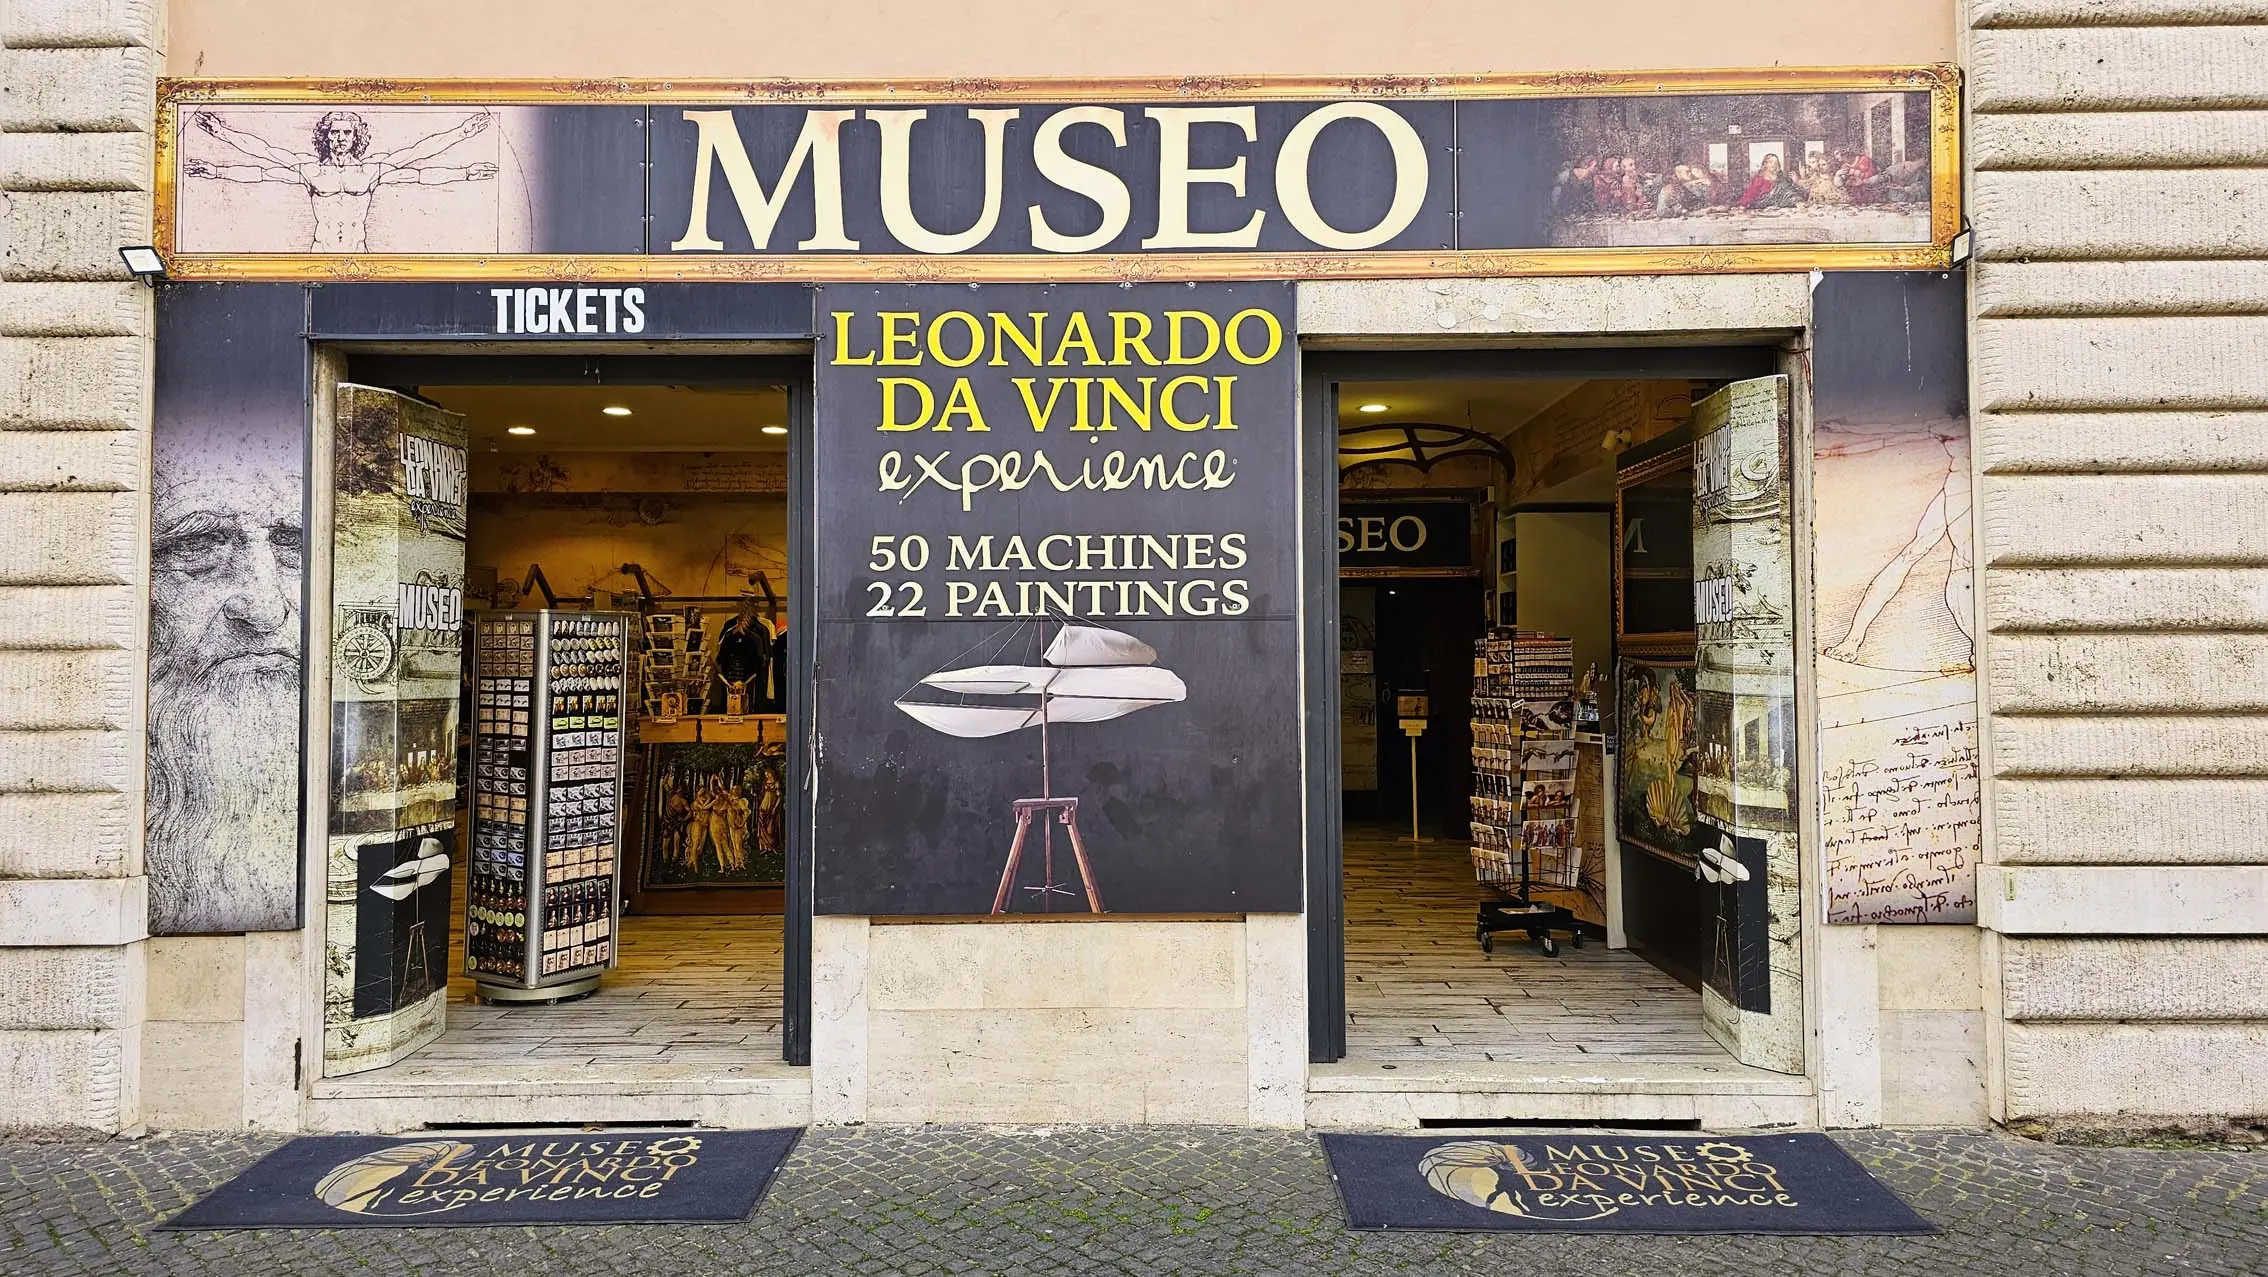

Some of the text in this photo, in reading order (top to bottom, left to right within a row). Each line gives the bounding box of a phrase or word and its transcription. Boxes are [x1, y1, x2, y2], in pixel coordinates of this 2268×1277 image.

[671, 101, 1429, 253] MUSEO
[490, 287, 645, 334] TICKETS
[830, 308, 1282, 367] LEONARDO
[877, 374, 1239, 432] DA VINCI
[399, 432, 467, 473] LEONARDO
[405, 460, 426, 499] DA
[878, 435, 1237, 511] experience
[869, 533, 1247, 571] 50 MACHINES
[1337, 515, 1427, 552] SEO
[399, 583, 462, 631] MUSEO
[866, 579, 1250, 618] 22 PAINTINGS
[1696, 575, 1733, 624] MUSEO
[410, 1164, 682, 1187] DA VINCI
[423, 1143, 697, 1170] LEONARDO
[1503, 1145, 1777, 1176] LEONARDO
[398, 1182, 662, 1207] experience
[1520, 1173, 1789, 1192] DA VINCI
[1538, 1191, 1798, 1213] experience
